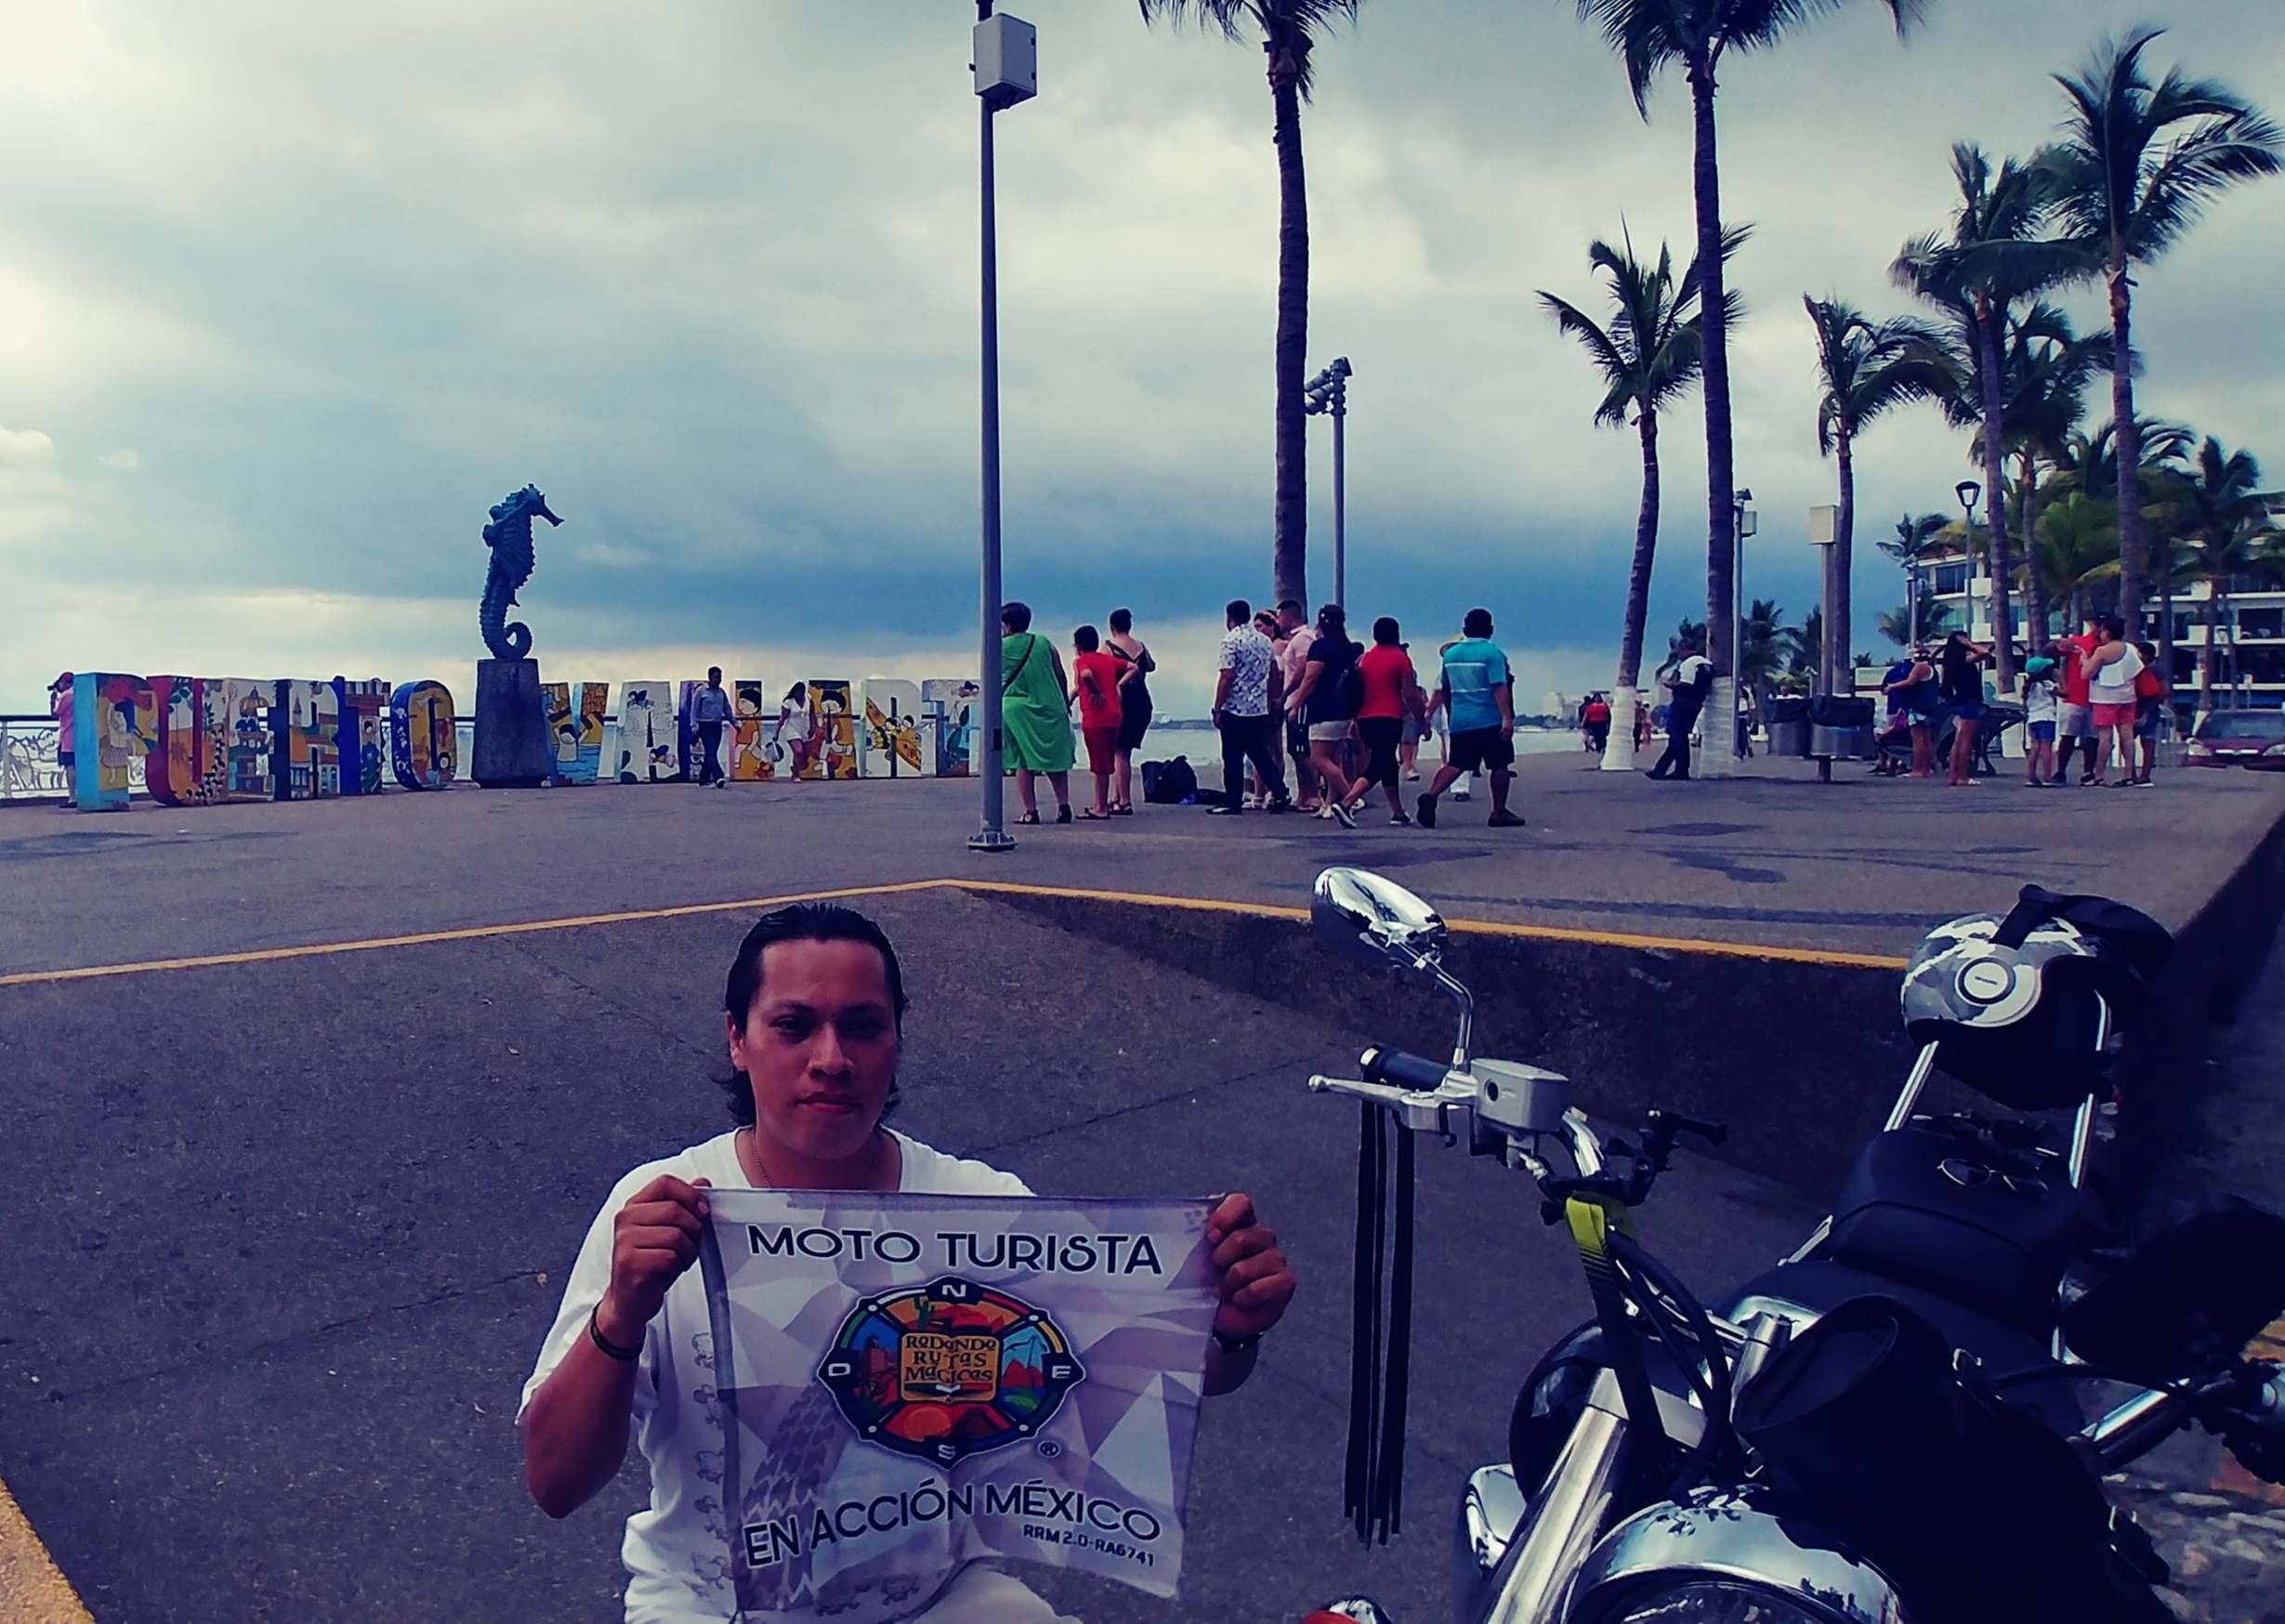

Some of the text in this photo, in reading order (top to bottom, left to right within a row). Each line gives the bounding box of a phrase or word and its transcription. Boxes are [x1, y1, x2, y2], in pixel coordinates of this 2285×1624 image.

[73, 672, 456, 812] PUERTO
[747, 1225, 1162, 1276] MOTO TURISTA
[941, 1284, 966, 1298] N
[827, 1363, 851, 1377] O
[1052, 1366, 1071, 1379] E
[938, 1444, 956, 1460] S
[744, 1478, 1161, 1567] EN ACCIÓN MÉXICO
[1023, 1524, 1060, 1544] RRM
